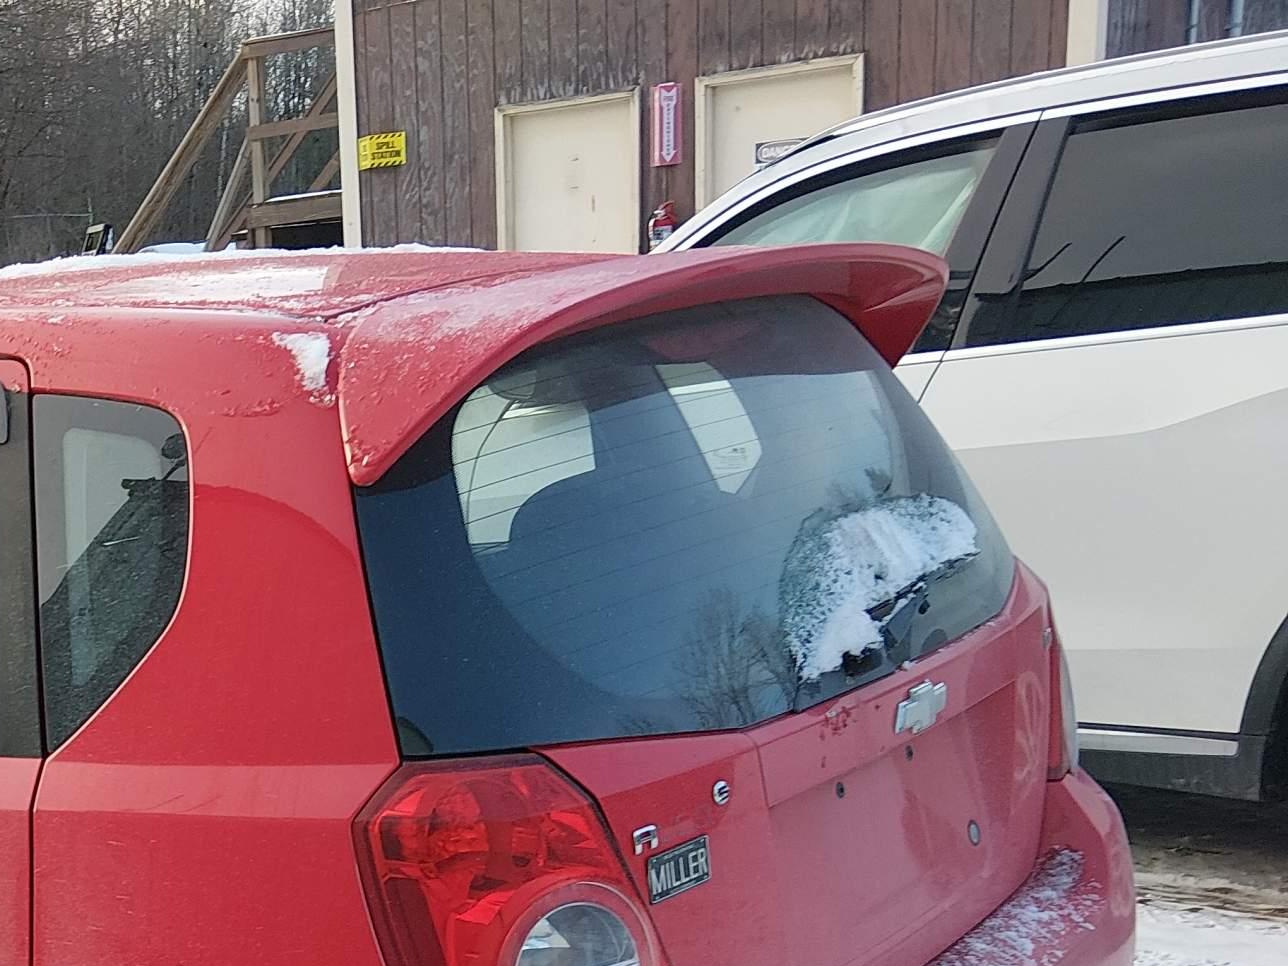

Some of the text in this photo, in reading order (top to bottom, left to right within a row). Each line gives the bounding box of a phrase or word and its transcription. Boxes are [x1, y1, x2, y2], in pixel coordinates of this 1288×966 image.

[375, 141, 398, 150] SPILL
[371, 149, 401, 160] STATION
[651, 847, 709, 895] MILLER
